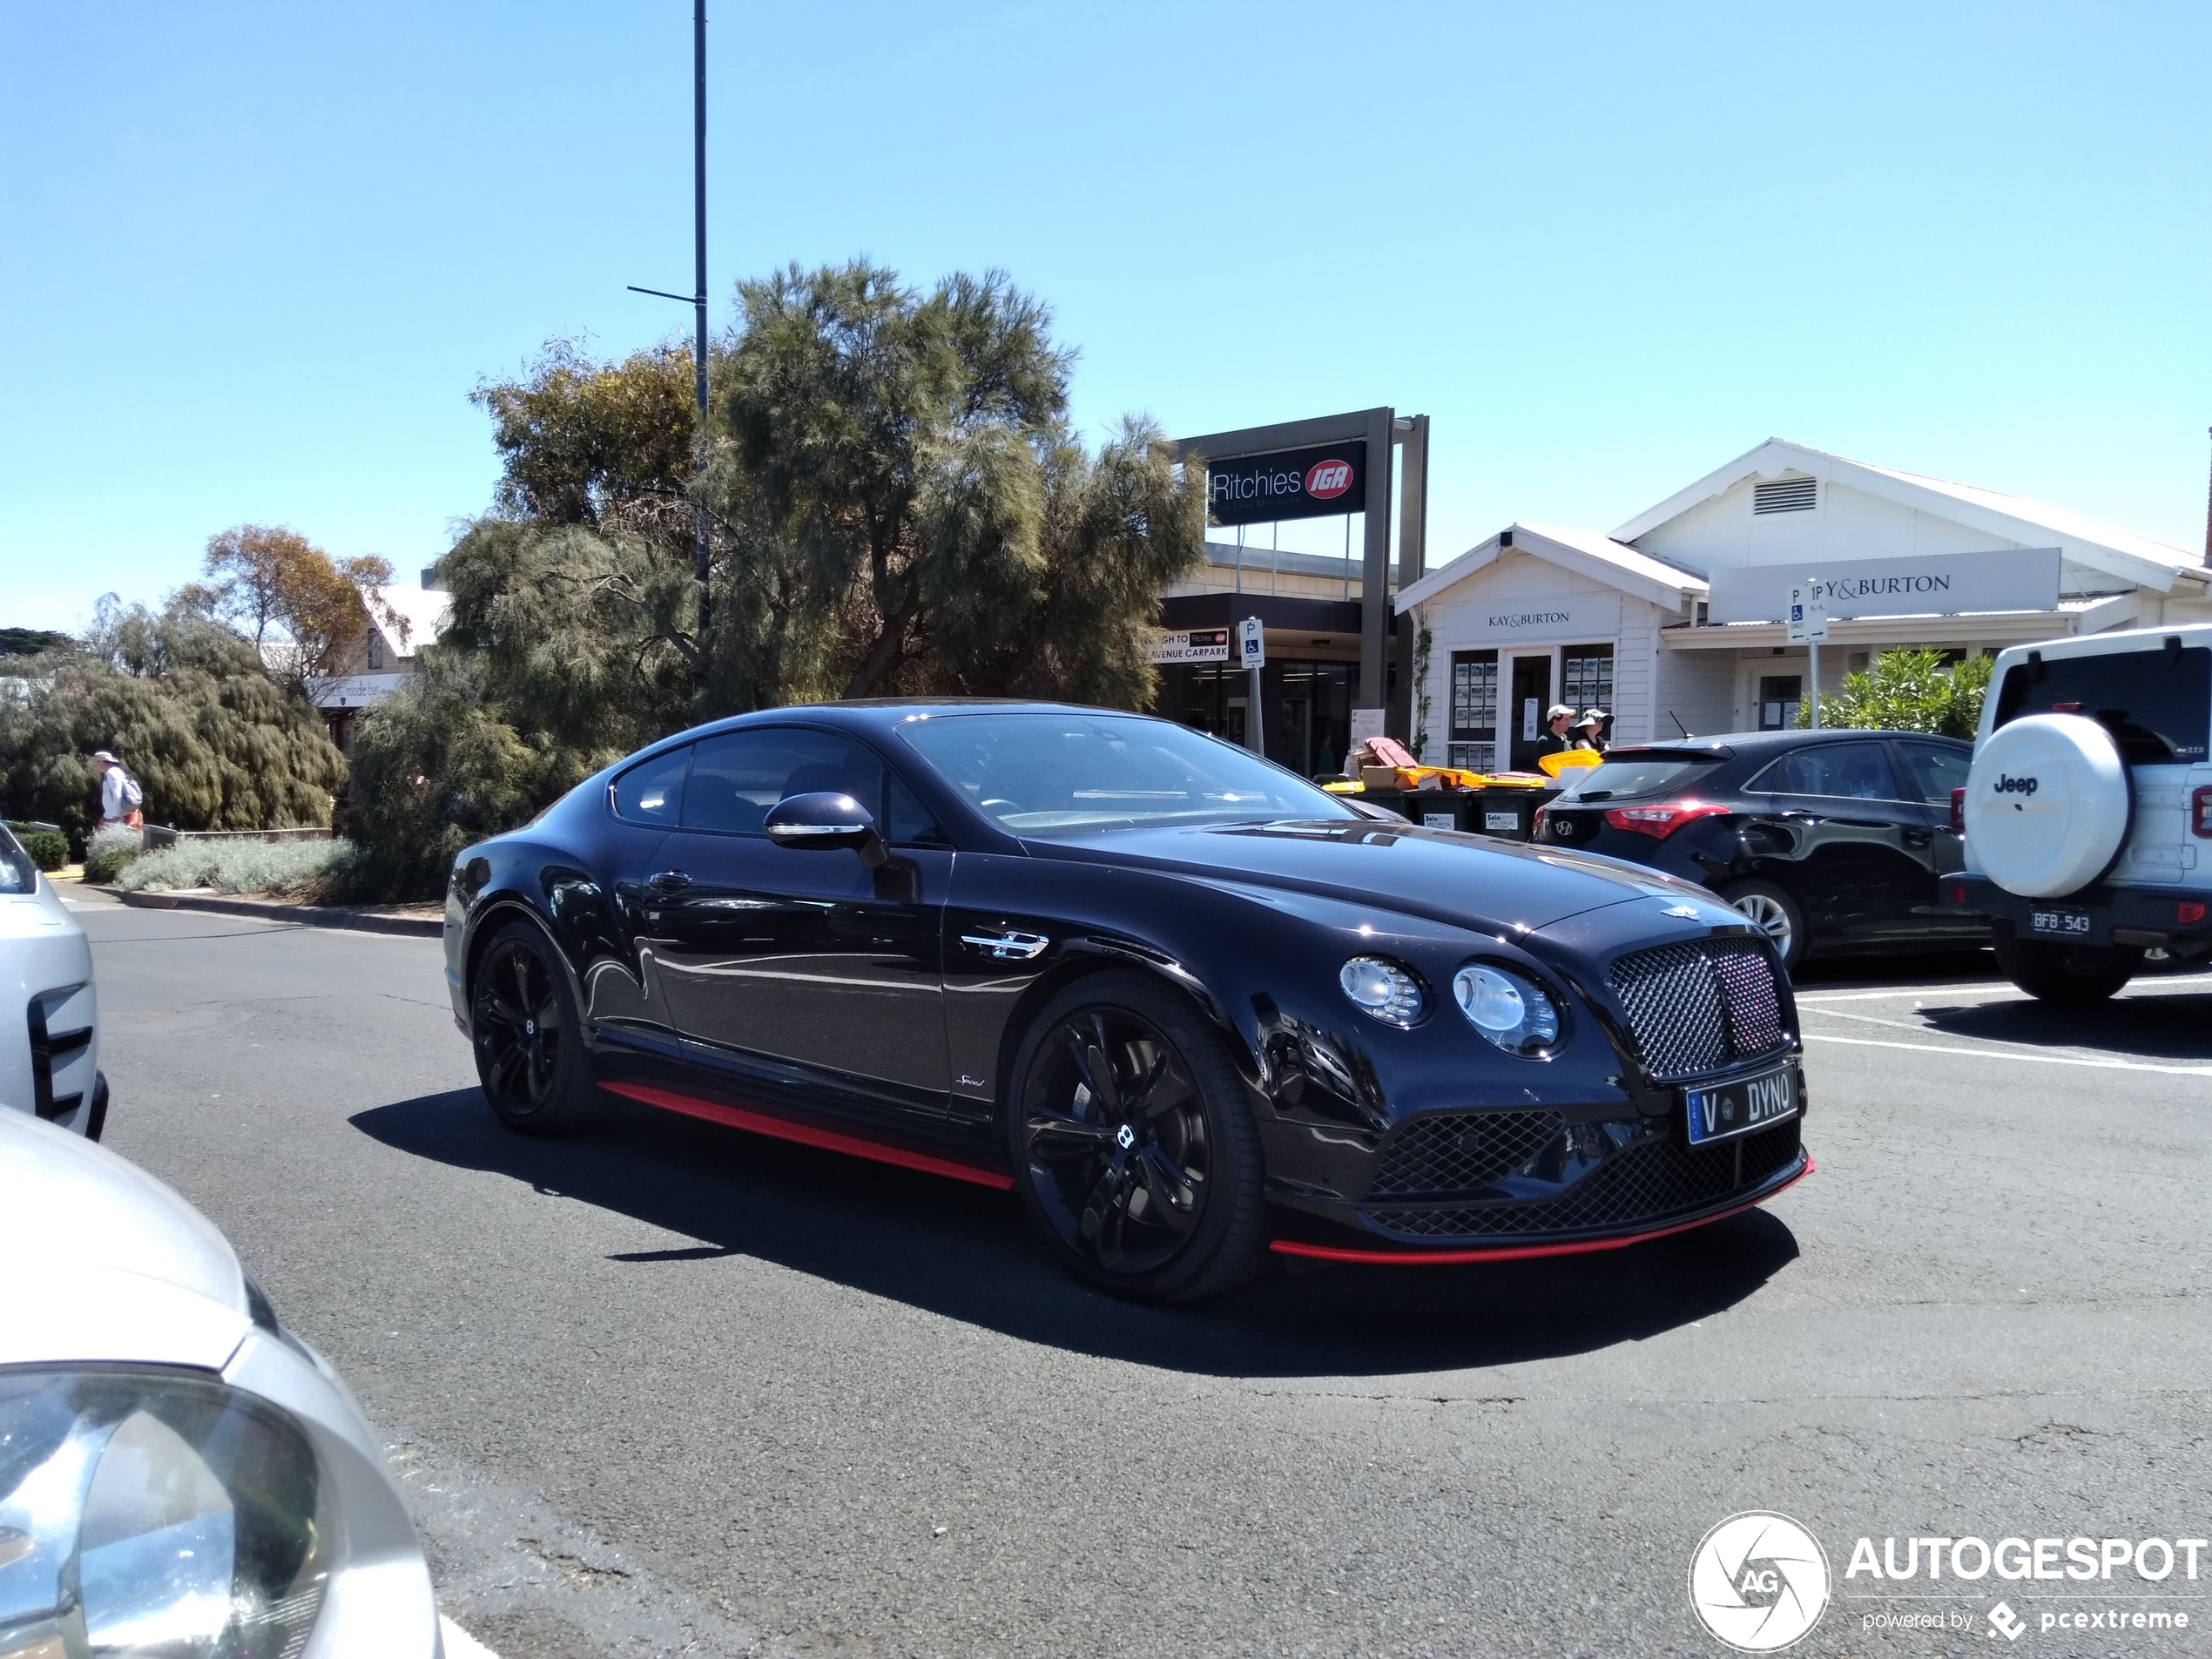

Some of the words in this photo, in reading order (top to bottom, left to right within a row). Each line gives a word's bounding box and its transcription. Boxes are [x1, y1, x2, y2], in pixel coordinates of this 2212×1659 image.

[1213, 469, 1300, 501] Ritchies
[1310, 466, 1348, 492] IGA
[1811, 585, 1823, 601] 1P
[1826, 575, 1951, 600] Y&BURTON
[1792, 590, 1800, 604] P
[1246, 623, 1256, 636] P
[1177, 635, 1188, 644] TO
[1150, 650, 1183, 659] AVENUE
[1185, 648, 1227, 658] CARPARK
[1993, 773, 2038, 797] Jeep
[955, 1075, 985, 1087] Speed
[1702, 1092, 1716, 1133] V
[1747, 1073, 1790, 1122] DYNO
